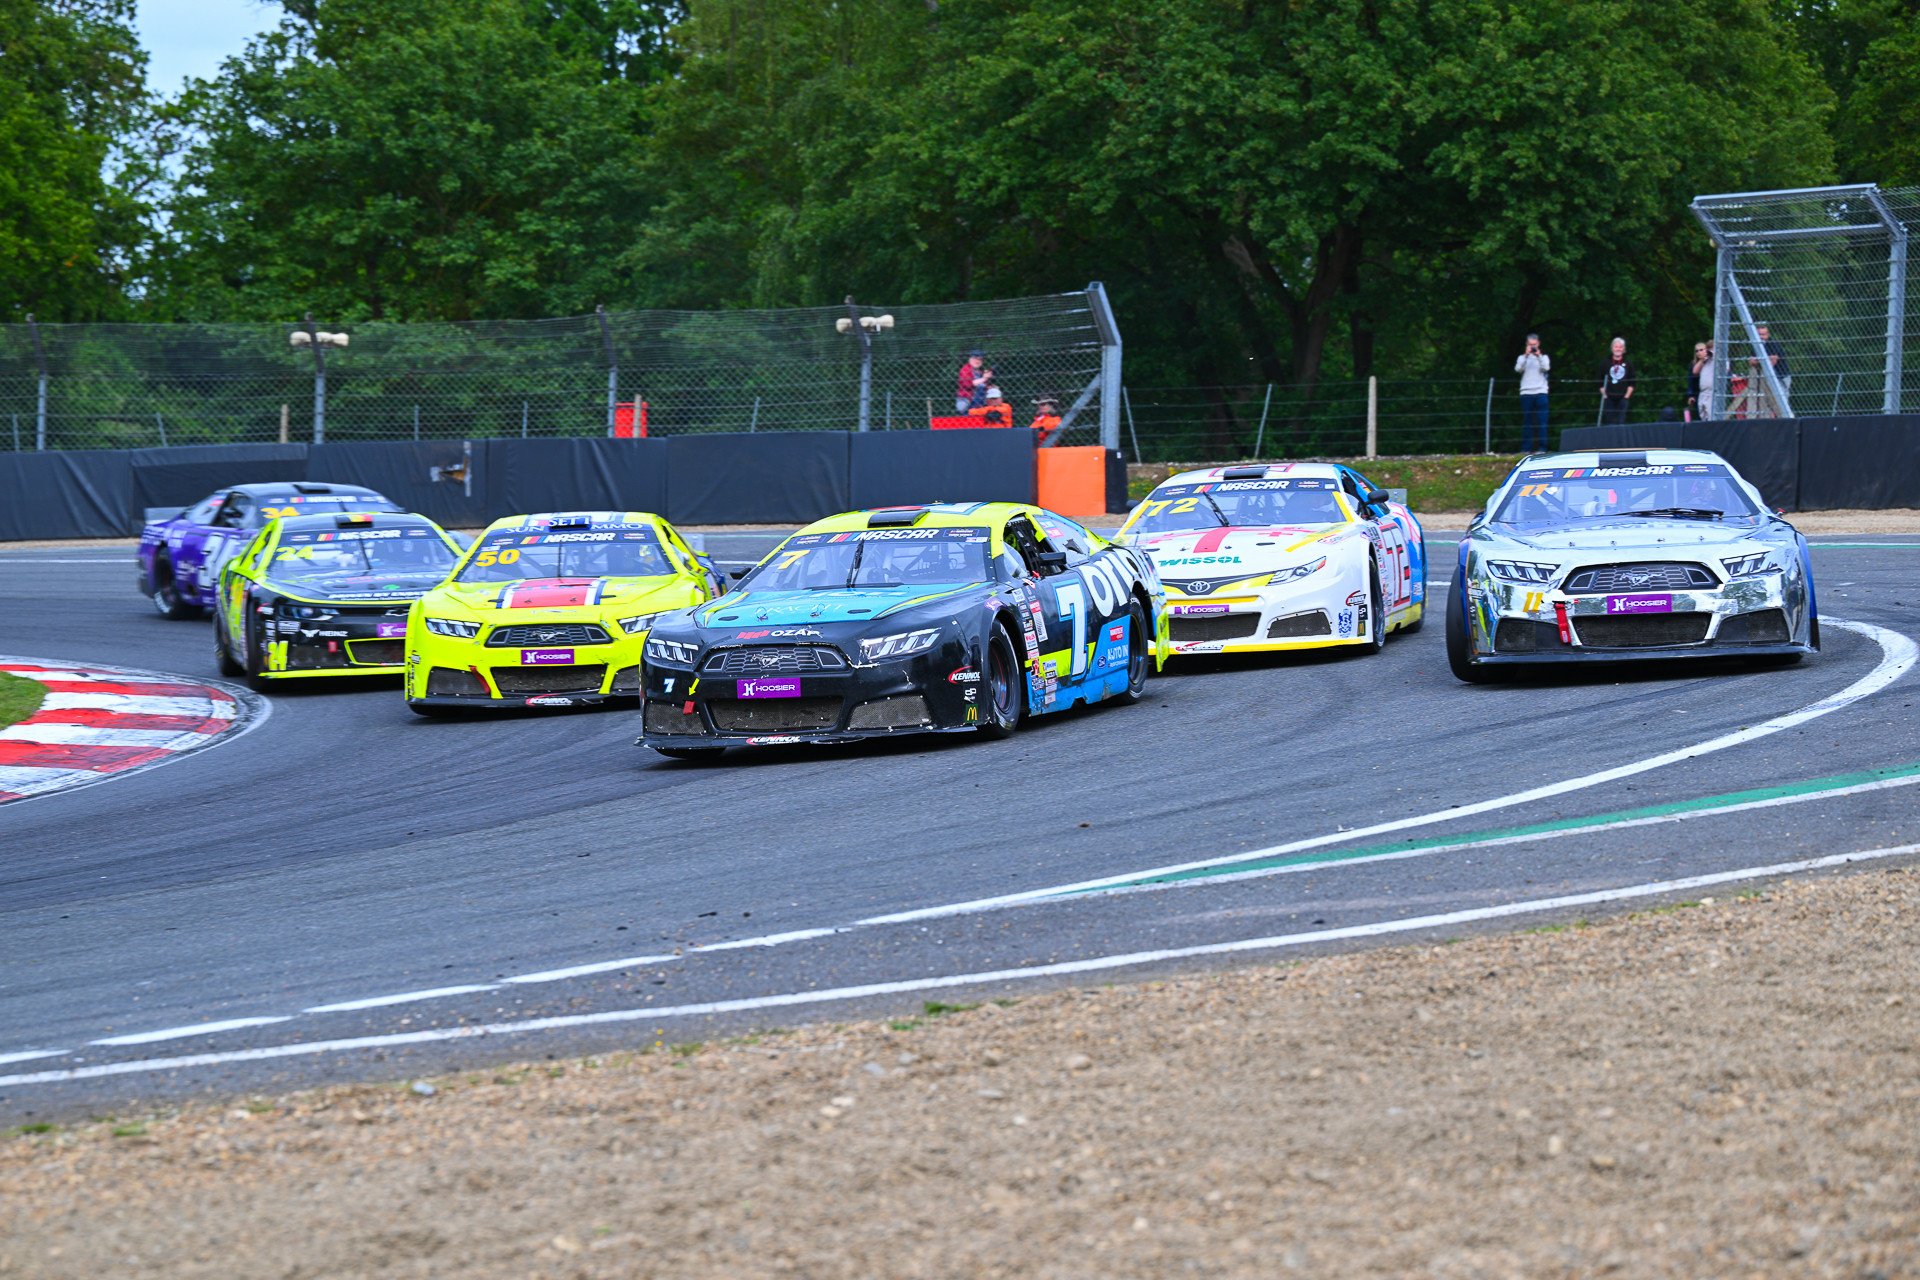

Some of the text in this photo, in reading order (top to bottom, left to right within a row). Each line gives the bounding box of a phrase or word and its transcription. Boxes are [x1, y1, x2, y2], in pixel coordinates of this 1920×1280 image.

[1590, 466, 1673, 476] NASCAR
[1217, 481, 1290, 491] NASCAR
[1518, 484, 1549, 496] 11
[261, 507, 300, 518] 34
[1148, 498, 1198, 516] 72
[339, 530, 401, 540] NASCAR
[543, 533, 616, 543] NASCAR
[853, 529, 939, 541] NASCAR
[276, 546, 313, 560] 24
[475, 549, 520, 567] 50
[778, 550, 811, 569] 7
[1158, 556, 1242, 567] WISSOL
[1523, 592, 1543, 613] 11
[1626, 599, 1667, 607] HOOSIER
[1053, 579, 1087, 681] 7
[951, 671, 981, 681] KENNOL
[664, 678, 676, 694] 7
[755, 684, 796, 692] HOOSIER
